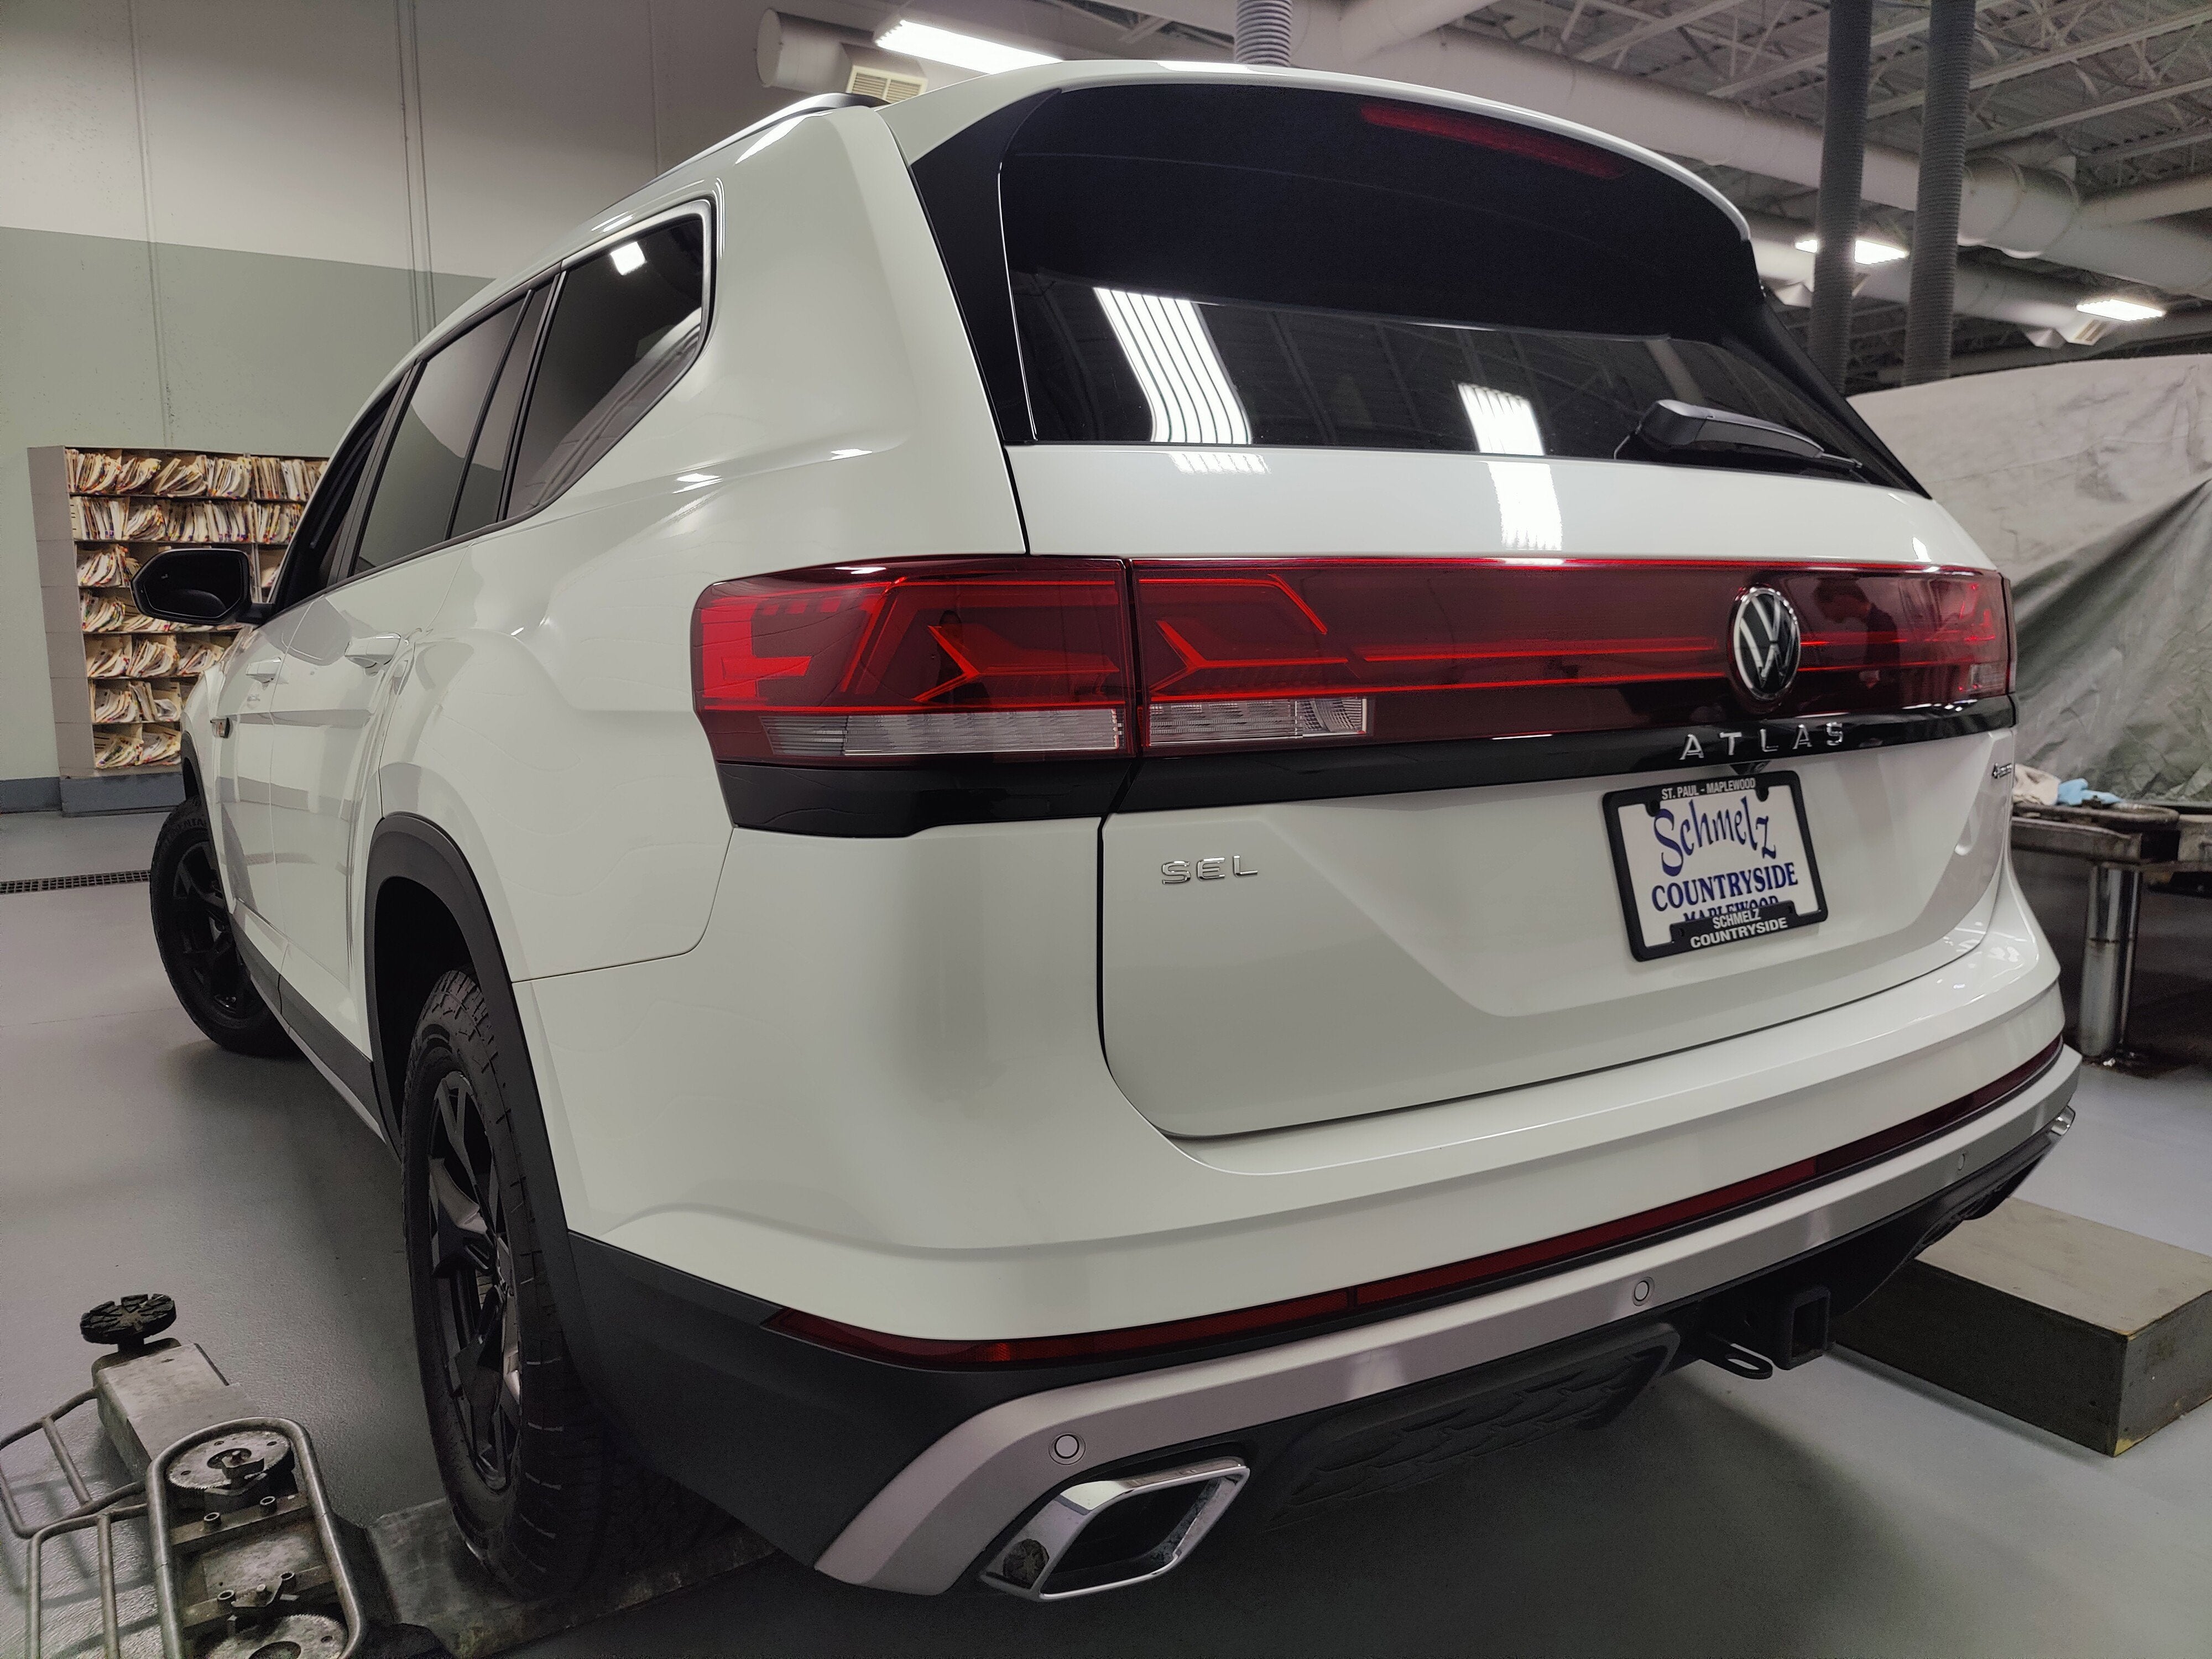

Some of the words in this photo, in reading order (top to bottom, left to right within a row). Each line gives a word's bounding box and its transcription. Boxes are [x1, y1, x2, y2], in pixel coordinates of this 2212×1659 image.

[1679, 721, 1843, 760] ATLAS
[1661, 788, 1676, 800] ST.
[1677, 785, 1699, 797] PAUL
[1706, 778, 1756, 794] MAPLEWOOD
[1653, 796, 1776, 877] Schmelz
[1162, 855, 1258, 885] SEL
[1651, 862, 1798, 911] COUNTRYSIDE
[1690, 917, 1788, 948] COUNTRYSIDE
[1712, 908, 1761, 930] SCHMELZ
